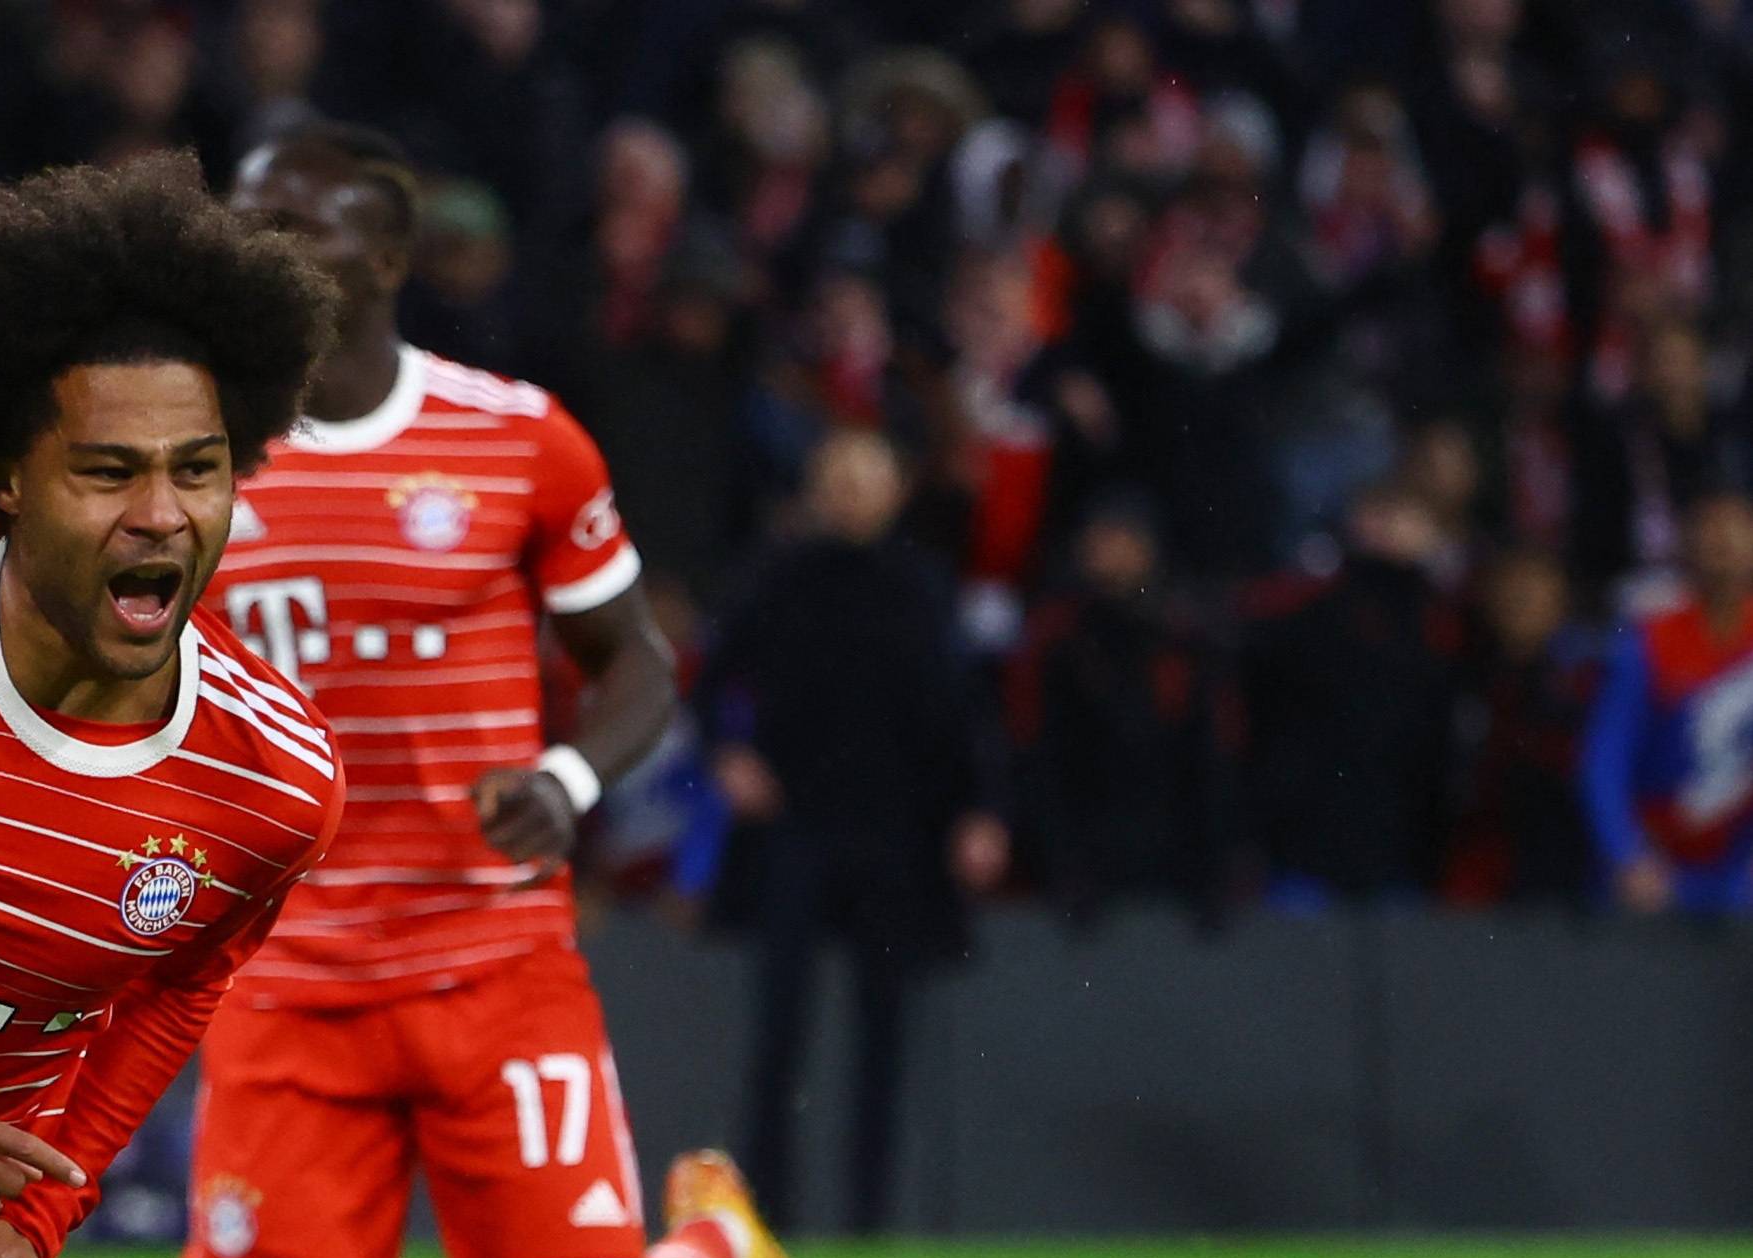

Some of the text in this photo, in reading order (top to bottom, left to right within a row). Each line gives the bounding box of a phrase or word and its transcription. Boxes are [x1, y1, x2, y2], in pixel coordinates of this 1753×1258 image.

[134, 864, 191, 898] FC BAYERN
[501, 1053, 591, 1168] 17
